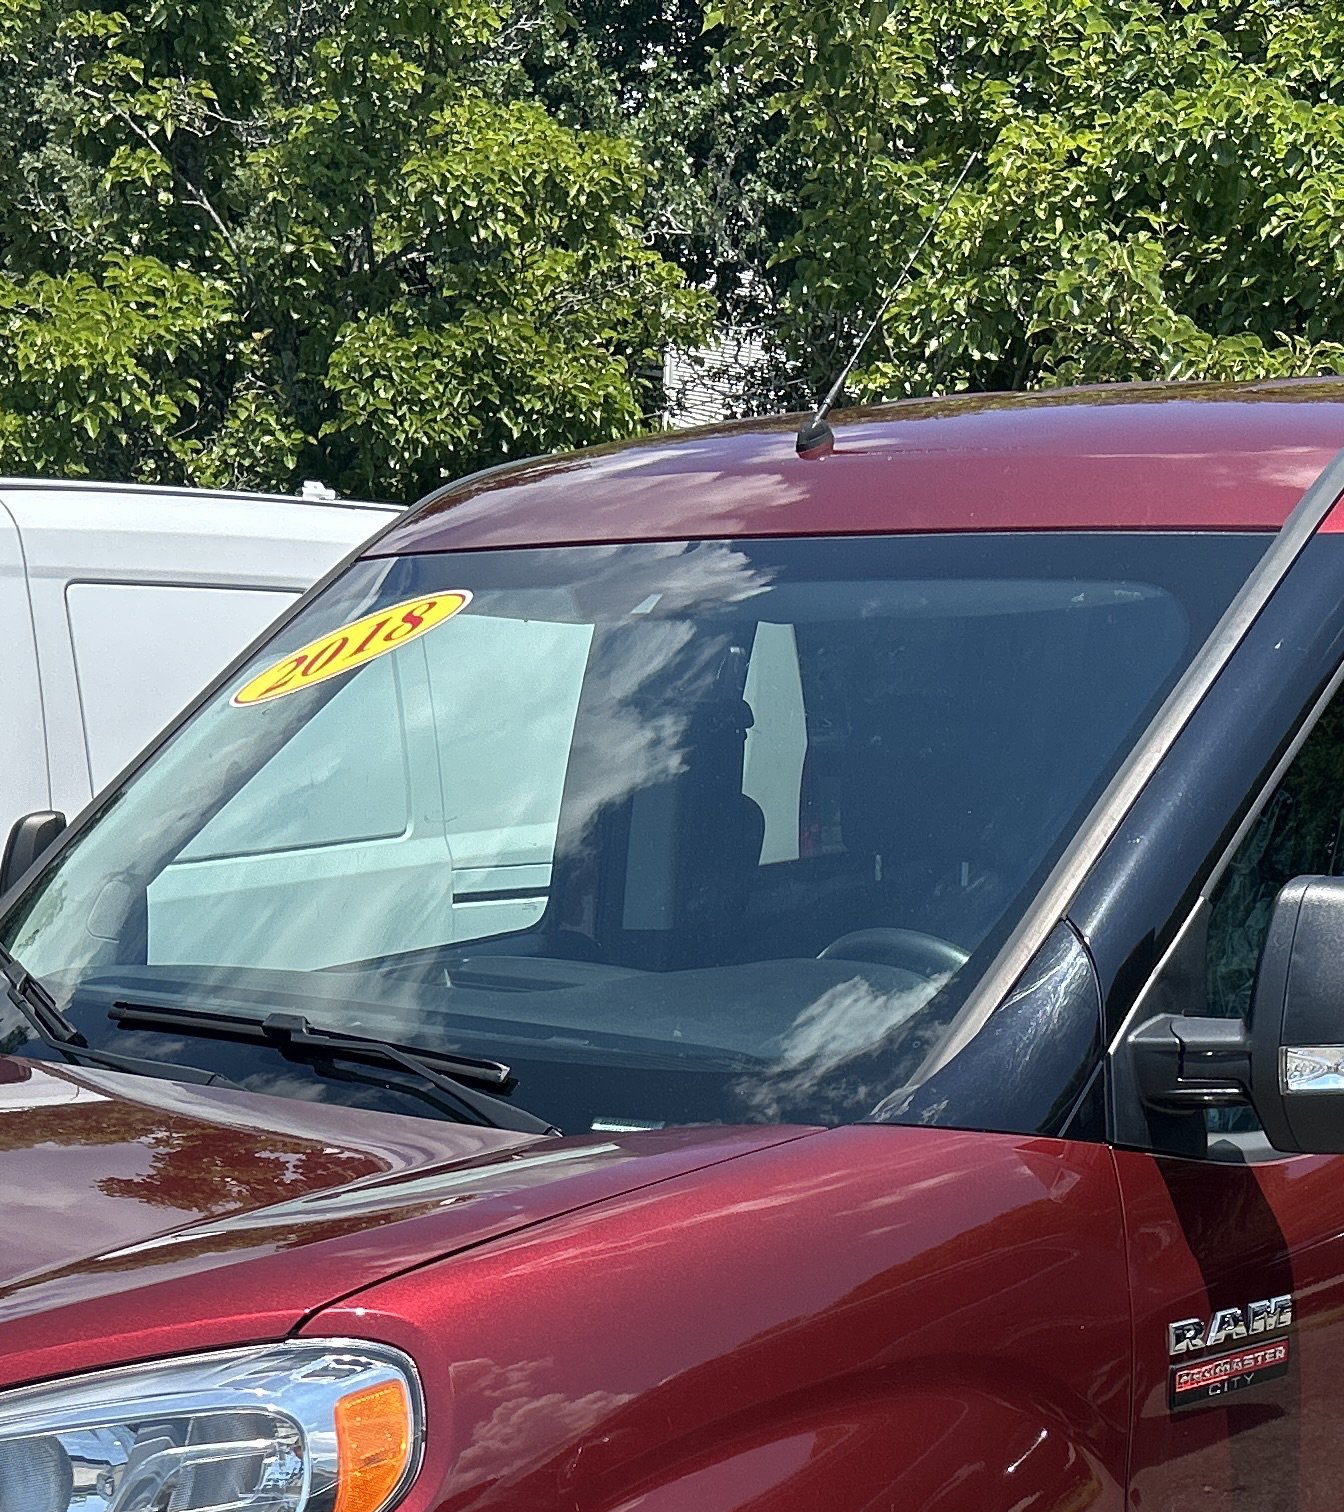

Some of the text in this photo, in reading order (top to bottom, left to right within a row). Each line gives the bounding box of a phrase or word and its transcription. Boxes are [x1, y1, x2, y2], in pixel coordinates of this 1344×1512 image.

[256, 601, 437, 699] 2018
[1169, 1294, 1292, 1355] RAM
[1209, 1373, 1254, 1395] CITY
